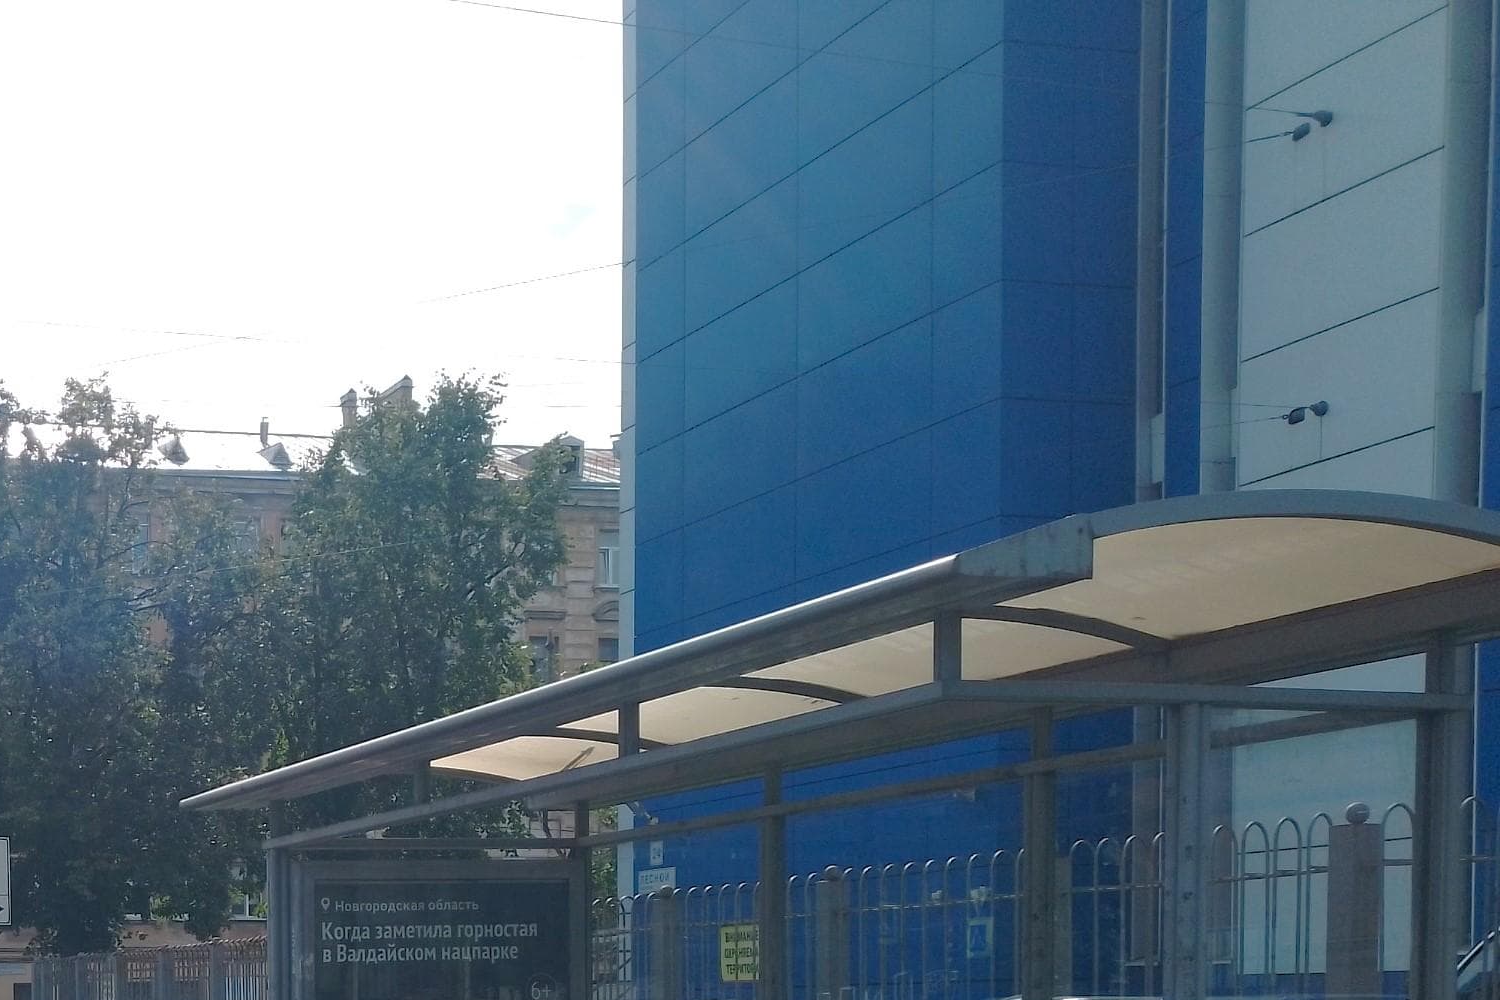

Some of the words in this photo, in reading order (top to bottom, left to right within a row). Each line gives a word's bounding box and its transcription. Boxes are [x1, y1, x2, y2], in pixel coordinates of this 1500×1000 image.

[335, 899, 425, 913] Новгородская
[428, 898, 479, 911] область
[321, 922, 371, 941] Когда
[375, 922, 452, 938] заметила
[457, 921, 538, 941] горностая
[323, 948, 332, 962] в
[336, 943, 436, 963] Валдайском
[441, 944, 518, 963] нацпарке
[531, 983, 552, 1000] 6+
